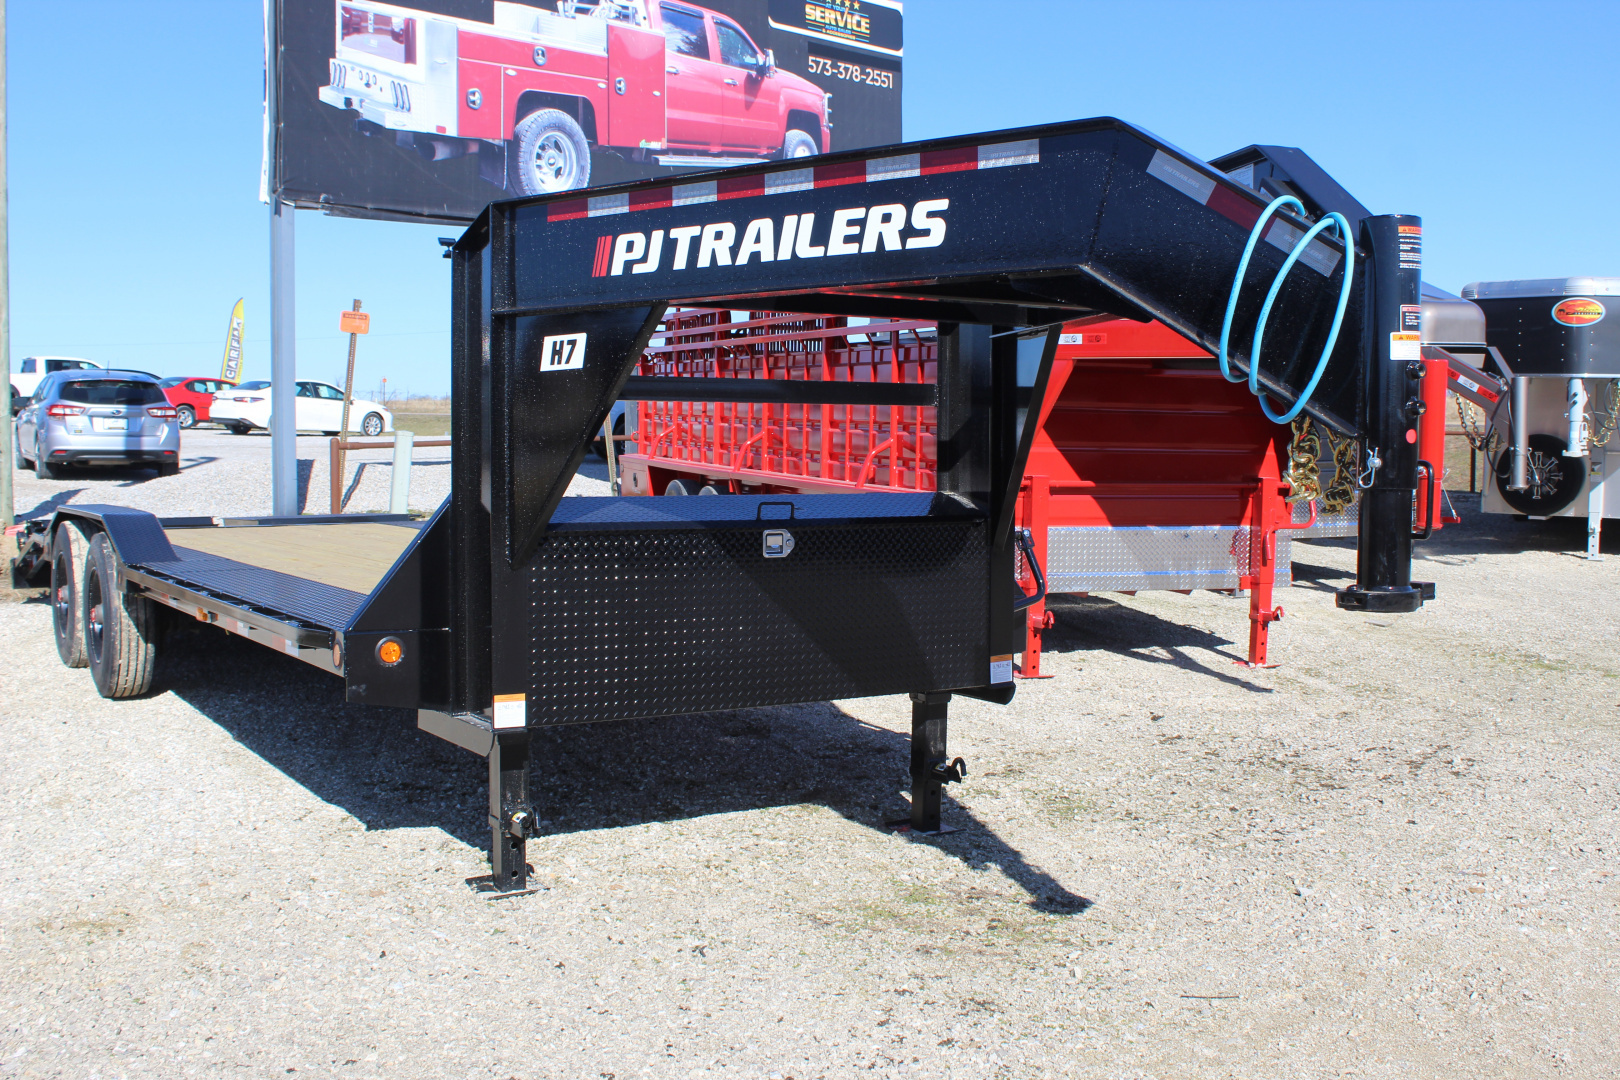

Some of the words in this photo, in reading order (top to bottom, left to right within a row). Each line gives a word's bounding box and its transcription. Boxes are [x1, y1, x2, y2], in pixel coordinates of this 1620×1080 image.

[805, 3, 870, 34] SERVICE
[808, 55, 893, 89] 573-378-2551
[610, 230, 665, 277] PJ
[669, 198, 950, 270] TRAILERS
[225, 316, 242, 379] CARFAX
[550, 338, 578, 366] H7
